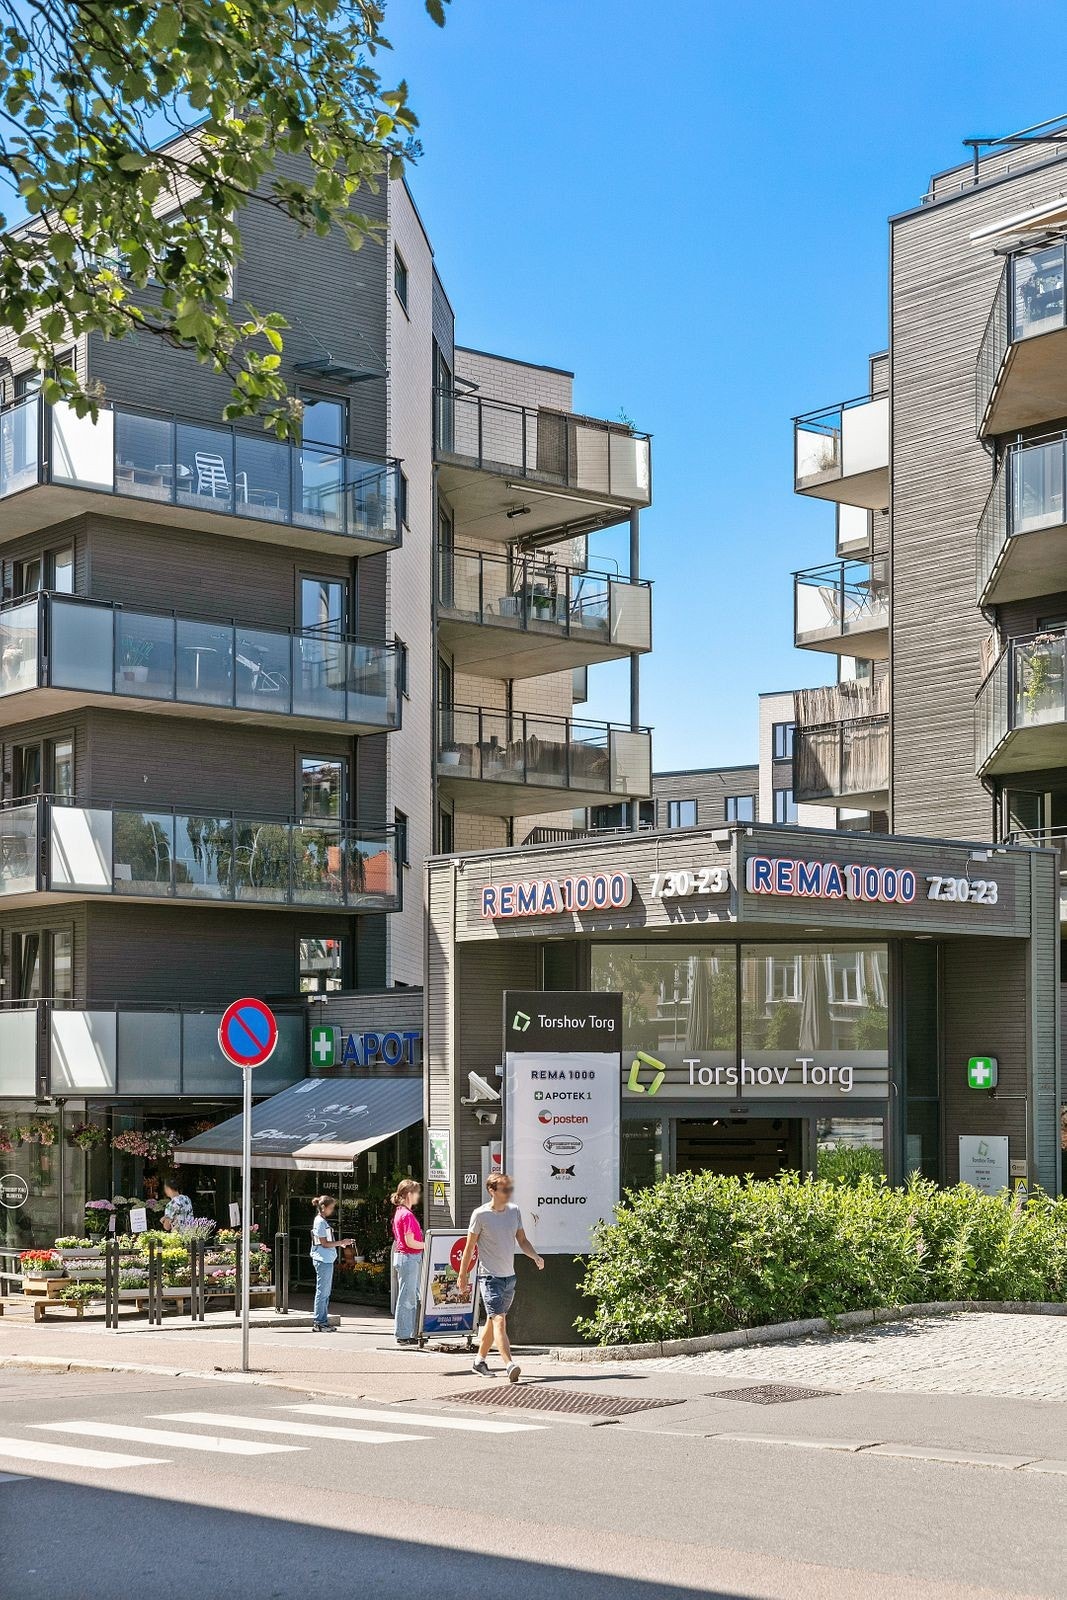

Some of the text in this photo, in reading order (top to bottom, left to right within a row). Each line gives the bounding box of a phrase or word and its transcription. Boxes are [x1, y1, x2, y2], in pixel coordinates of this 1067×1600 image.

[650, 868, 728, 897] 7.30-23
[746, 857, 916, 903] REMA 1000
[927, 876, 998, 904] 7.30-23
[482, 871, 632, 918] REMA 1000
[538, 1014, 615, 1032] Torshov Torg
[341, 1032, 420, 1066] APOT
[531, 1070, 596, 1080] REMA 1000
[682, 1057, 854, 1093] Torshov Torg
[545, 1091, 593, 1101] APOTEK 1
[553, 1113, 589, 1126] posten
[537, 1196, 587, 1206] panduro
